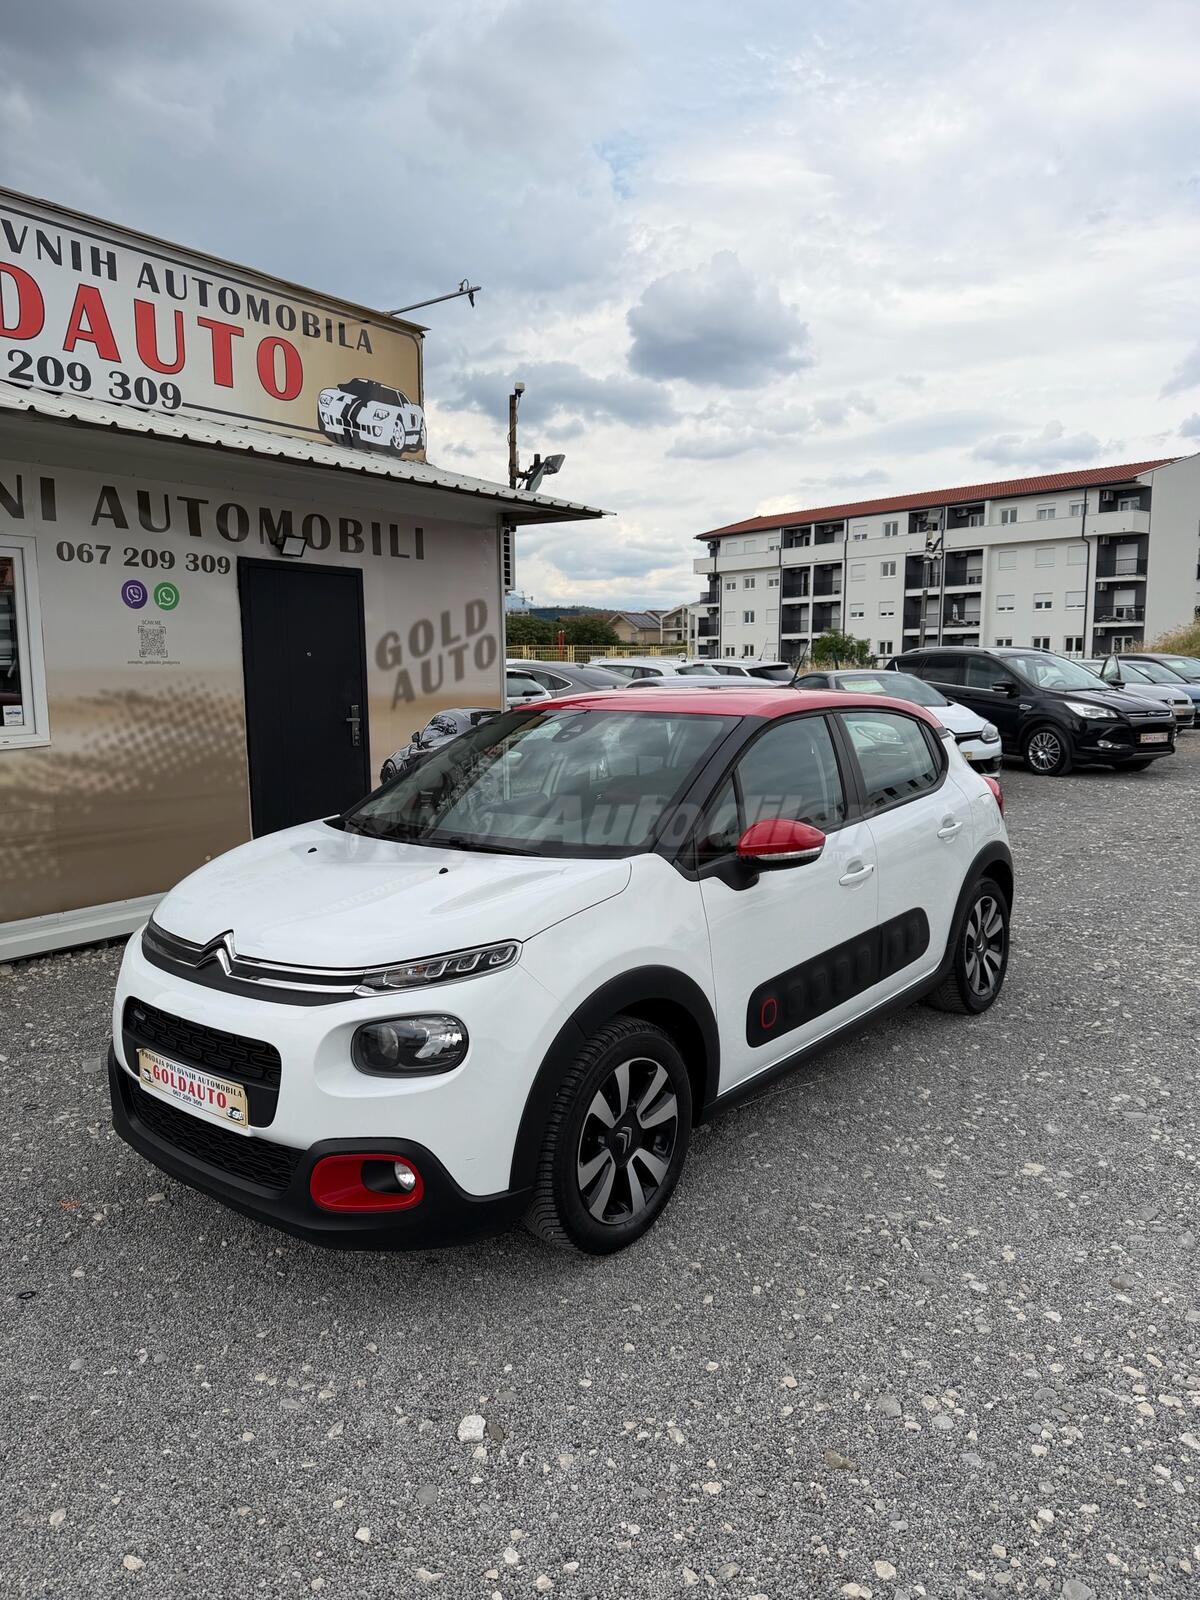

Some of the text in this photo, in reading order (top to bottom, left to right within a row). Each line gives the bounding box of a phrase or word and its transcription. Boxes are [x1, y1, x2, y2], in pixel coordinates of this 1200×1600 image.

[0, 218, 373, 355] VNIH AUTOMOBILA
[7, 349, 182, 410] 209 309
[91, 485, 424, 560] AUTOMOBILI
[56, 541, 231, 575] 067 209 309
[375, 598, 488, 671] GOLD
[391, 633, 497, 711] AUTO
[141, 1050, 243, 1098] PRODAJA POLOVNIH AUTOMOBILA
[153, 1064, 227, 1109] GOLDAUTO
